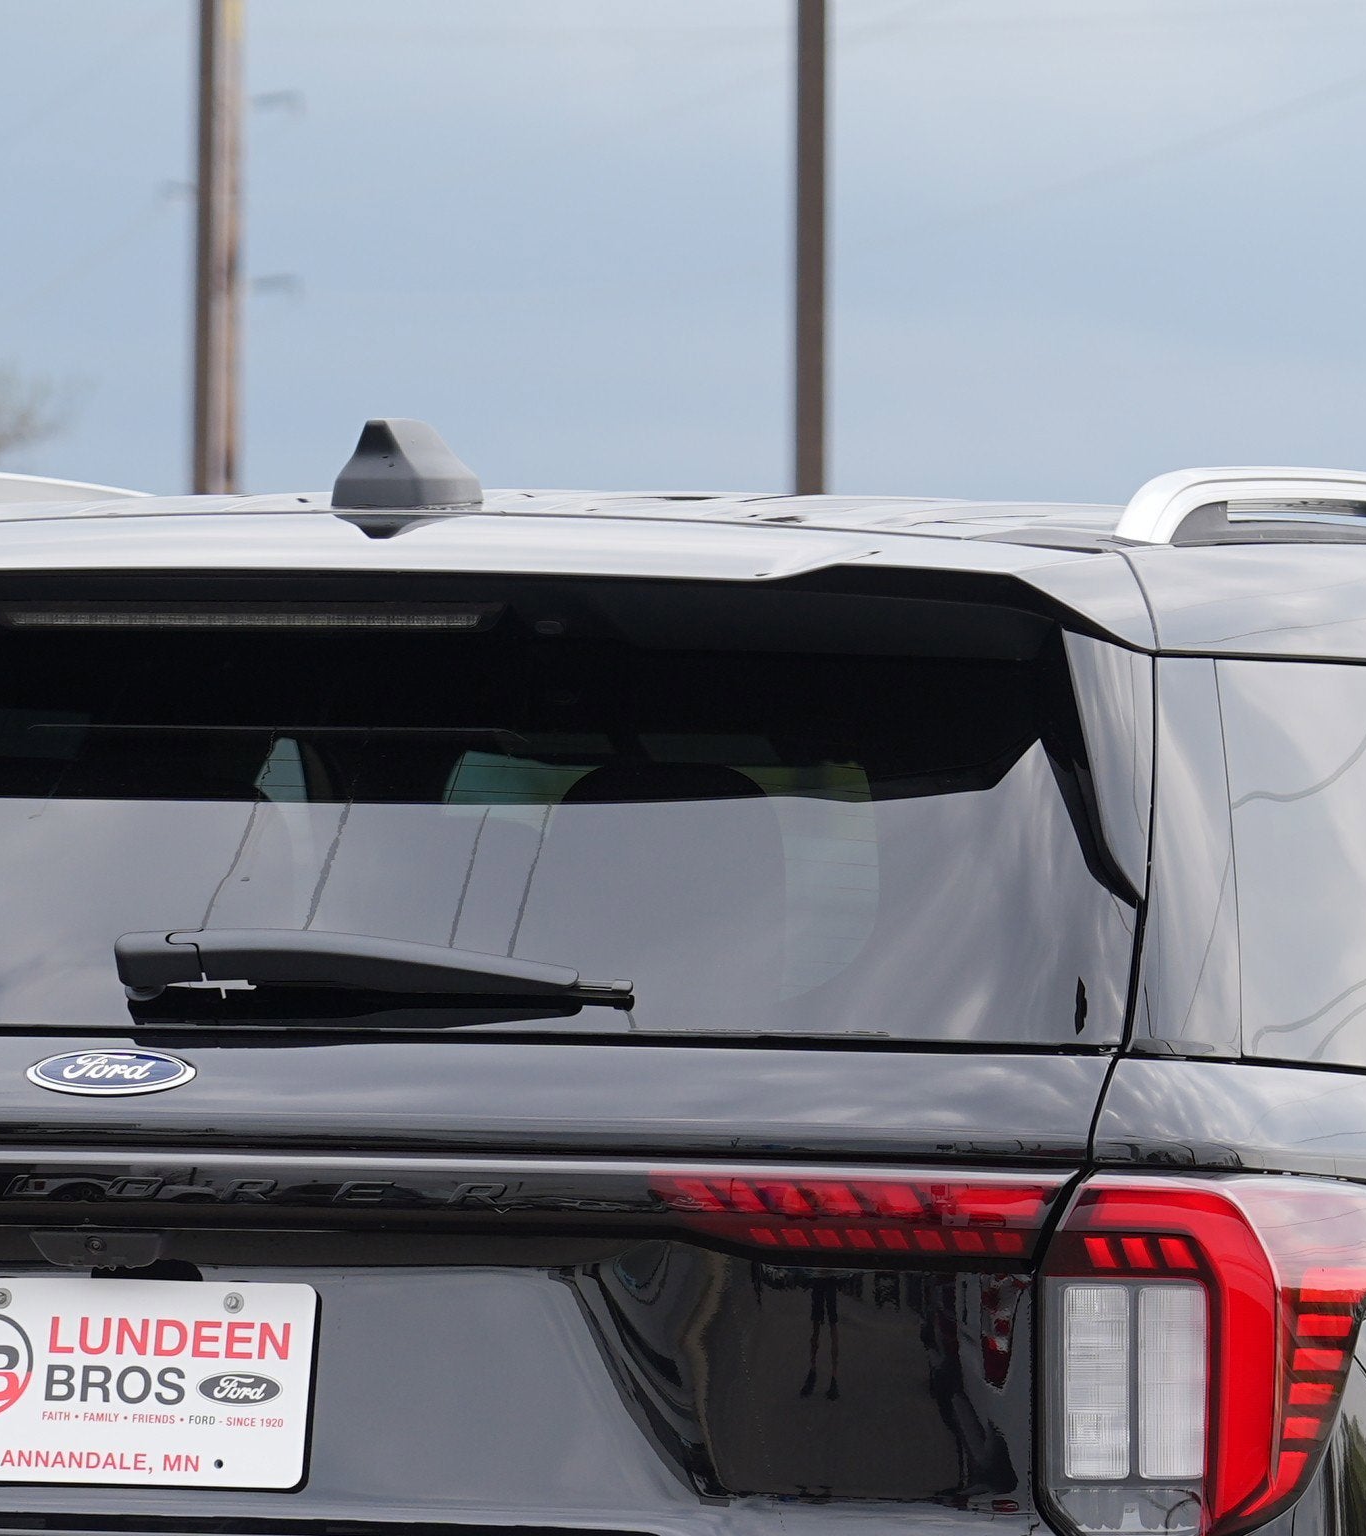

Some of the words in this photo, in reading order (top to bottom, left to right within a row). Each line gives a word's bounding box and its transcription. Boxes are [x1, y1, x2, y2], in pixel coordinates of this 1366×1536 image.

[63, 1053, 156, 1080] Ford
[48, 1316, 292, 1361] LUNDEEN
[44, 1363, 186, 1406] BROS
[212, 1373, 266, 1401] Ford
[42, 1411, 70, 1421] FAITH
[83, 1412, 120, 1423] FAMILY
[132, 1414, 176, 1424] FRIENDS
[188, 1415, 216, 1425] FORD
[226, 1417, 257, 1428] SINCE
[260, 1417, 285, 1428] 1920
[0, 1449, 154, 1474] ANNANDALE,
[162, 1454, 201, 1473] MN
